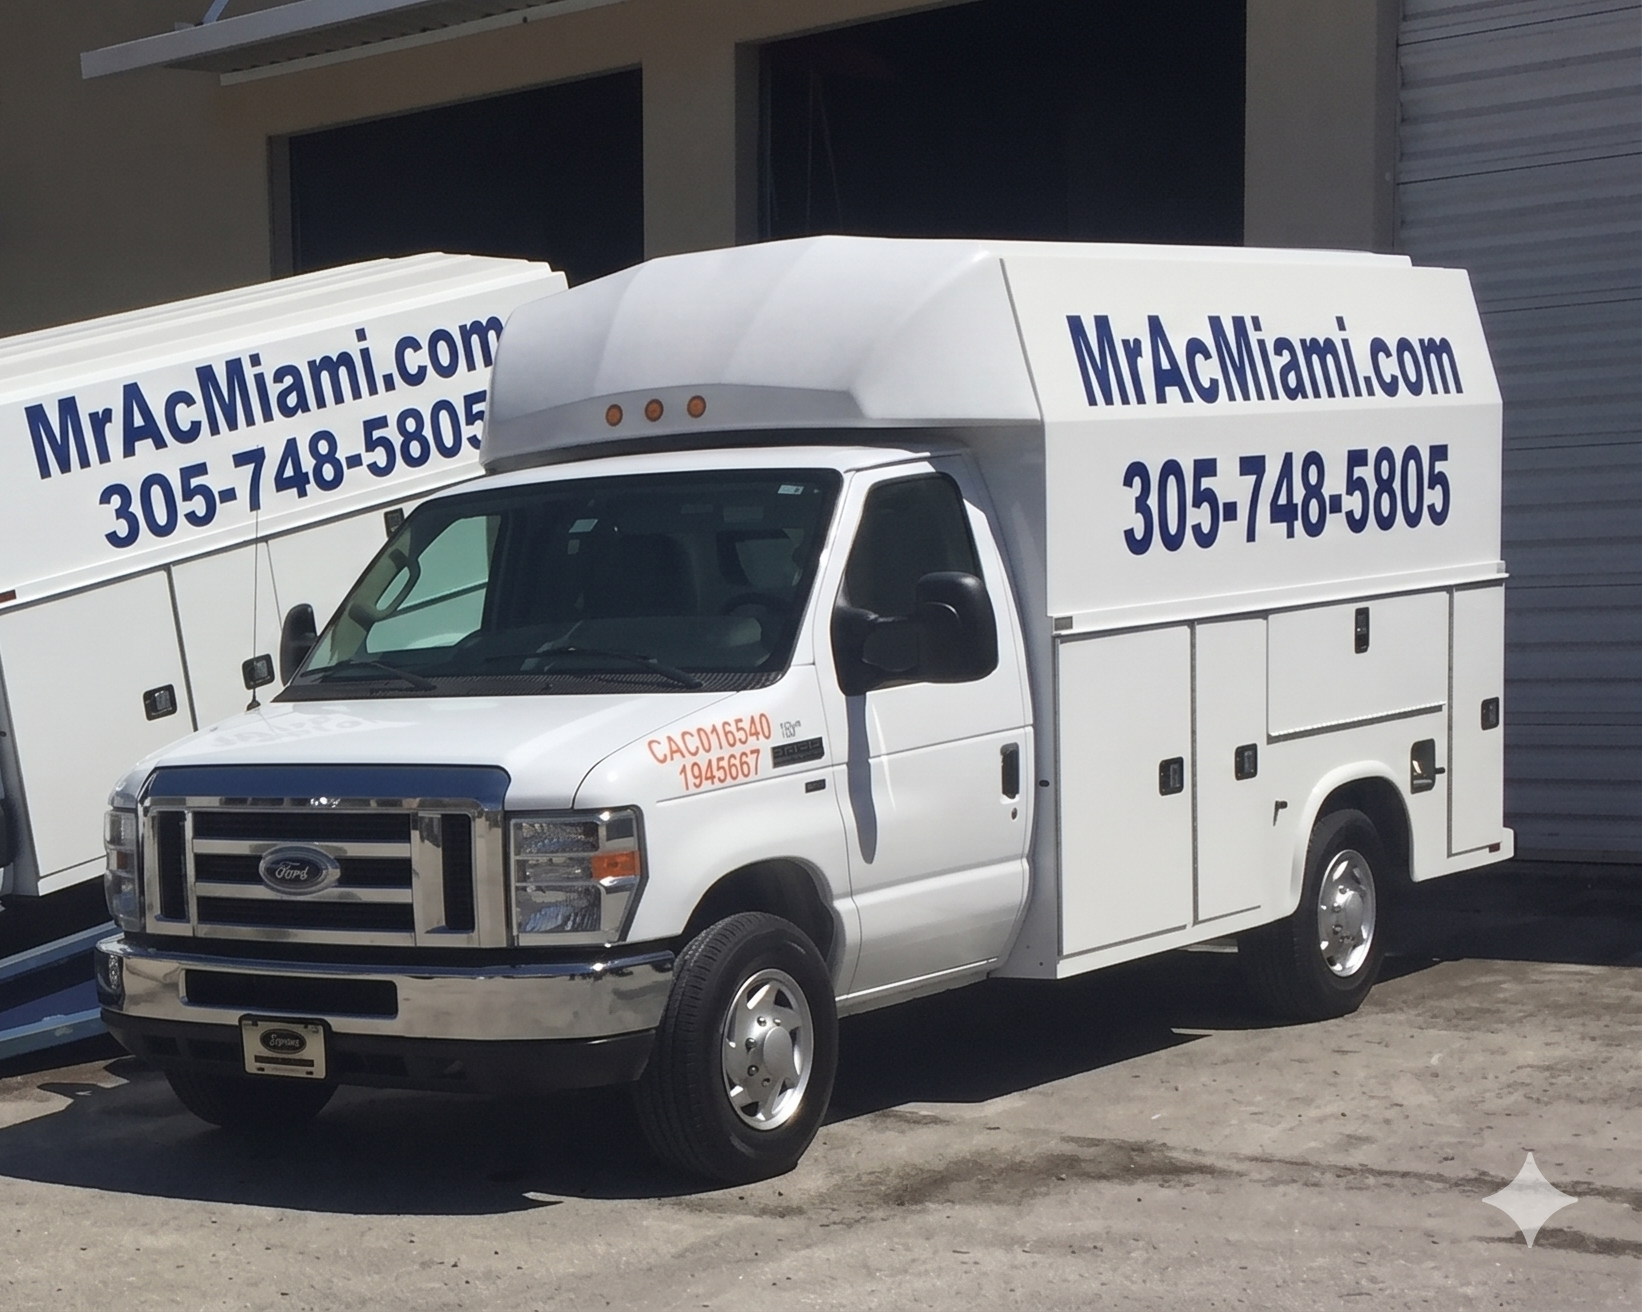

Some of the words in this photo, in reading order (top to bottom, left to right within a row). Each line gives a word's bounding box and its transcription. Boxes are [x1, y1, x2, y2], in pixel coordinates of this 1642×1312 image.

[24, 315, 504, 480] MrAcMiami.com
[1065, 314, 1464, 407] MrAcMiami.com
[98, 390, 488, 549] 305-748-5805
[1122, 443, 1451, 556] 305-748-5805
[647, 712, 772, 765] CAC016540
[679, 748, 761, 791] 1945667
[275, 861, 310, 880] Ford
